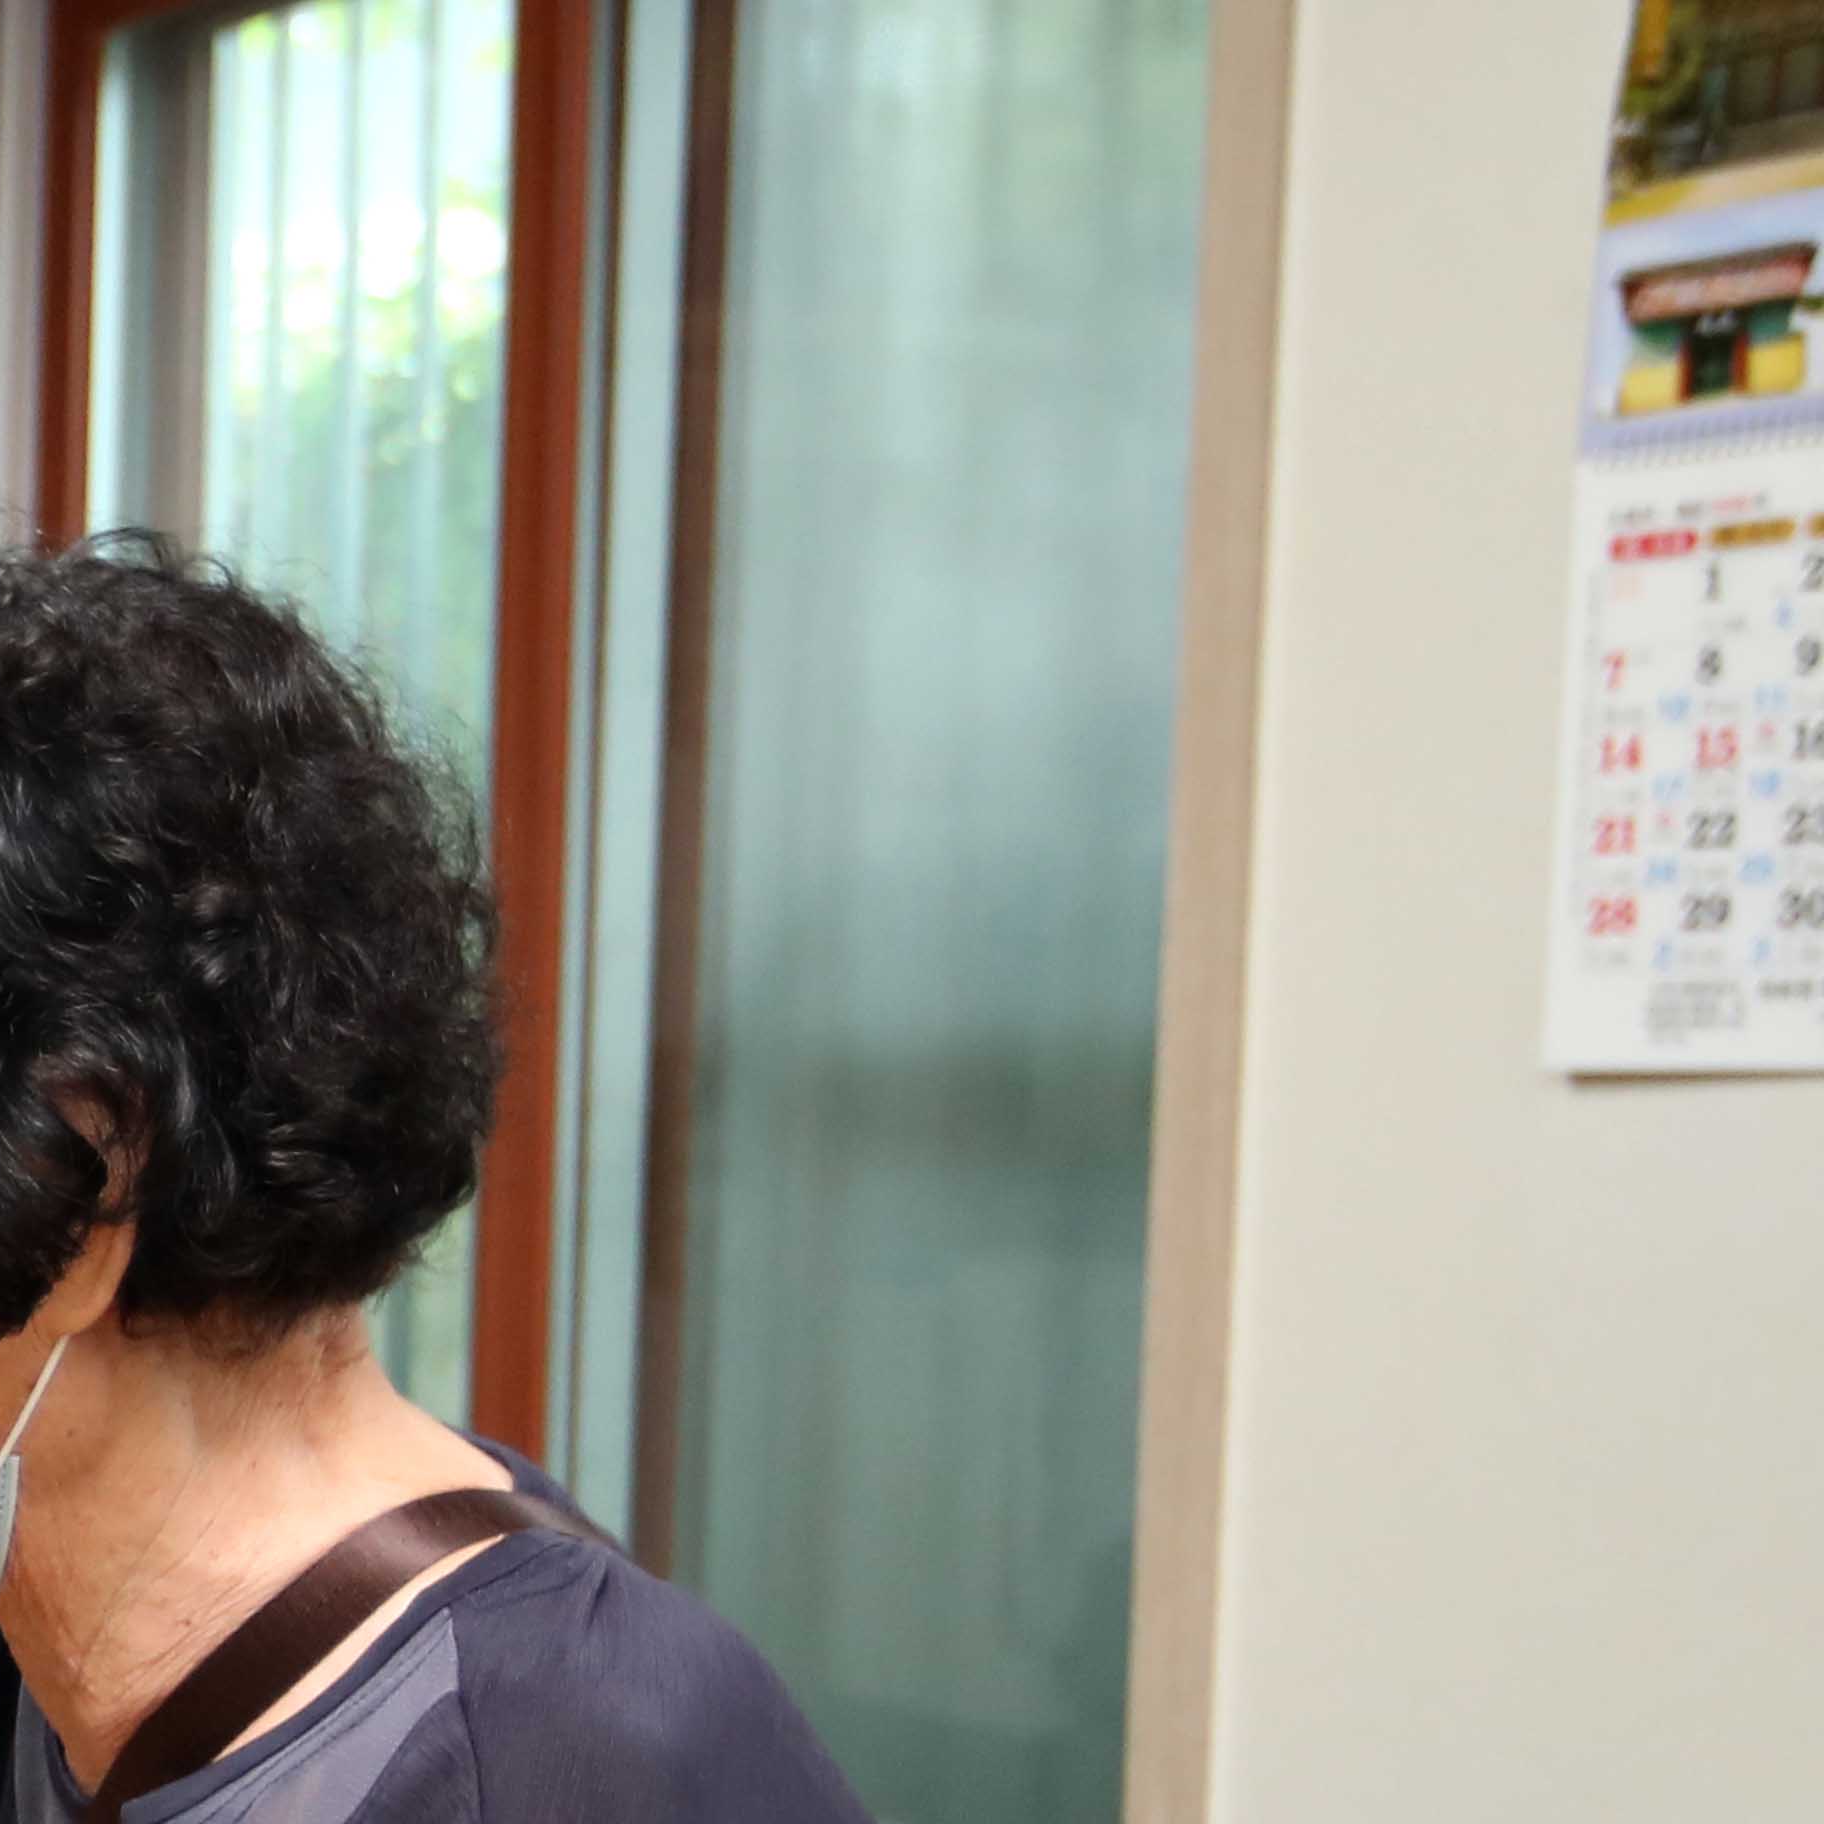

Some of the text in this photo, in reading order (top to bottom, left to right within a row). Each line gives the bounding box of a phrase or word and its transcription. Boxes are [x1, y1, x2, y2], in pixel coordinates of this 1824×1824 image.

[1802, 551, 1824, 592] 2
[1602, 636, 1822, 692] 7 8 9
[1601, 733, 1643, 774] 14
[1696, 723, 1740, 769] 15
[1592, 813, 1637, 855] 21
[1685, 807, 1736, 849] 22
[1588, 894, 1638, 937] 28
[1680, 888, 1733, 931] 29
